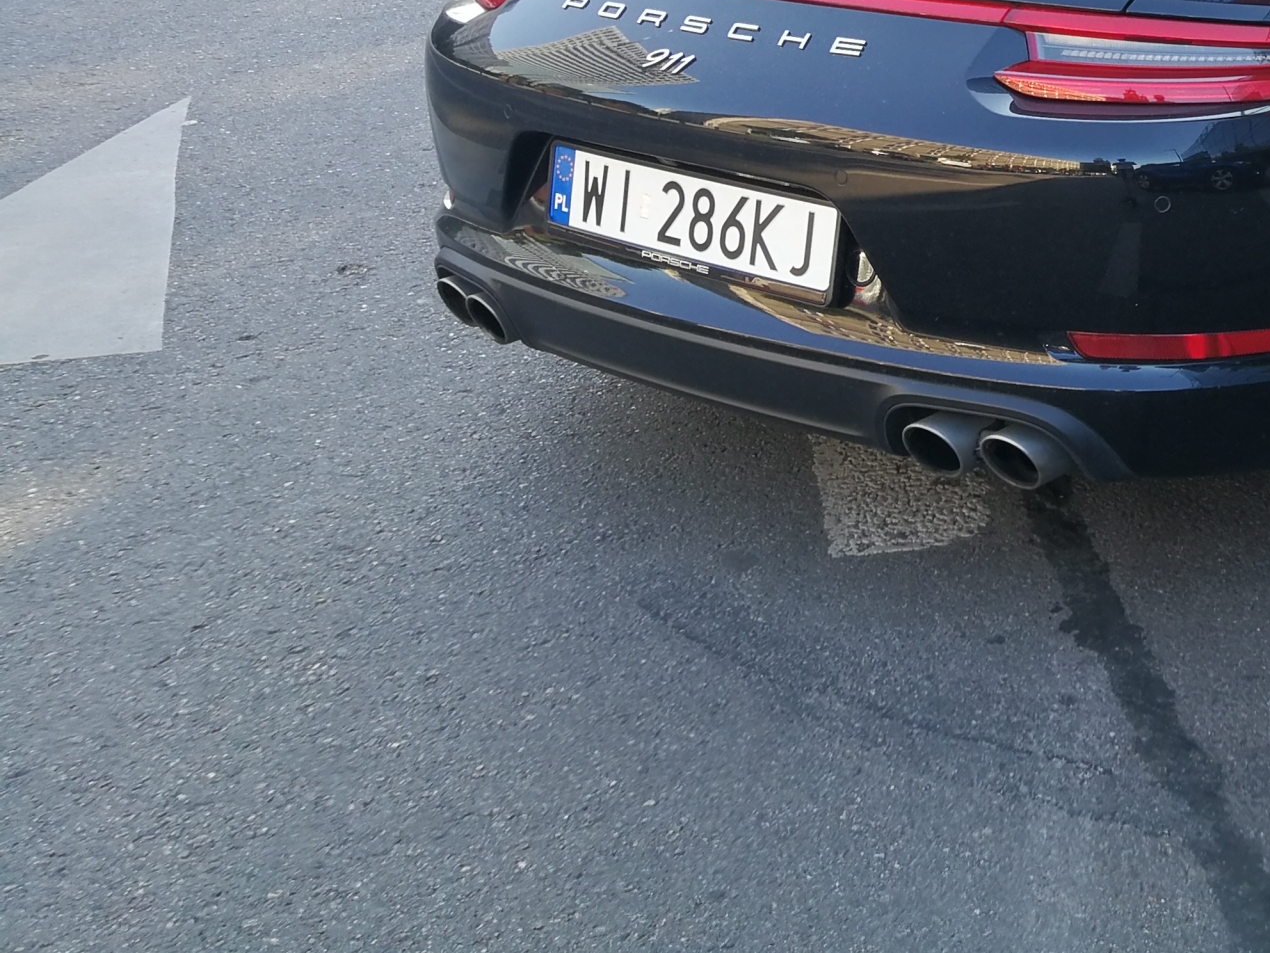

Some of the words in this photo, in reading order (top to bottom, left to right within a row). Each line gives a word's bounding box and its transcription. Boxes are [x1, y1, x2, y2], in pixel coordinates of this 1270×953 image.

[641, 48, 696, 74] 911
[553, 192, 570, 214] PL
[582, 159, 631, 233] WI
[656, 180, 816, 277] 286KJ
[641, 250, 711, 275] PORSCHE
